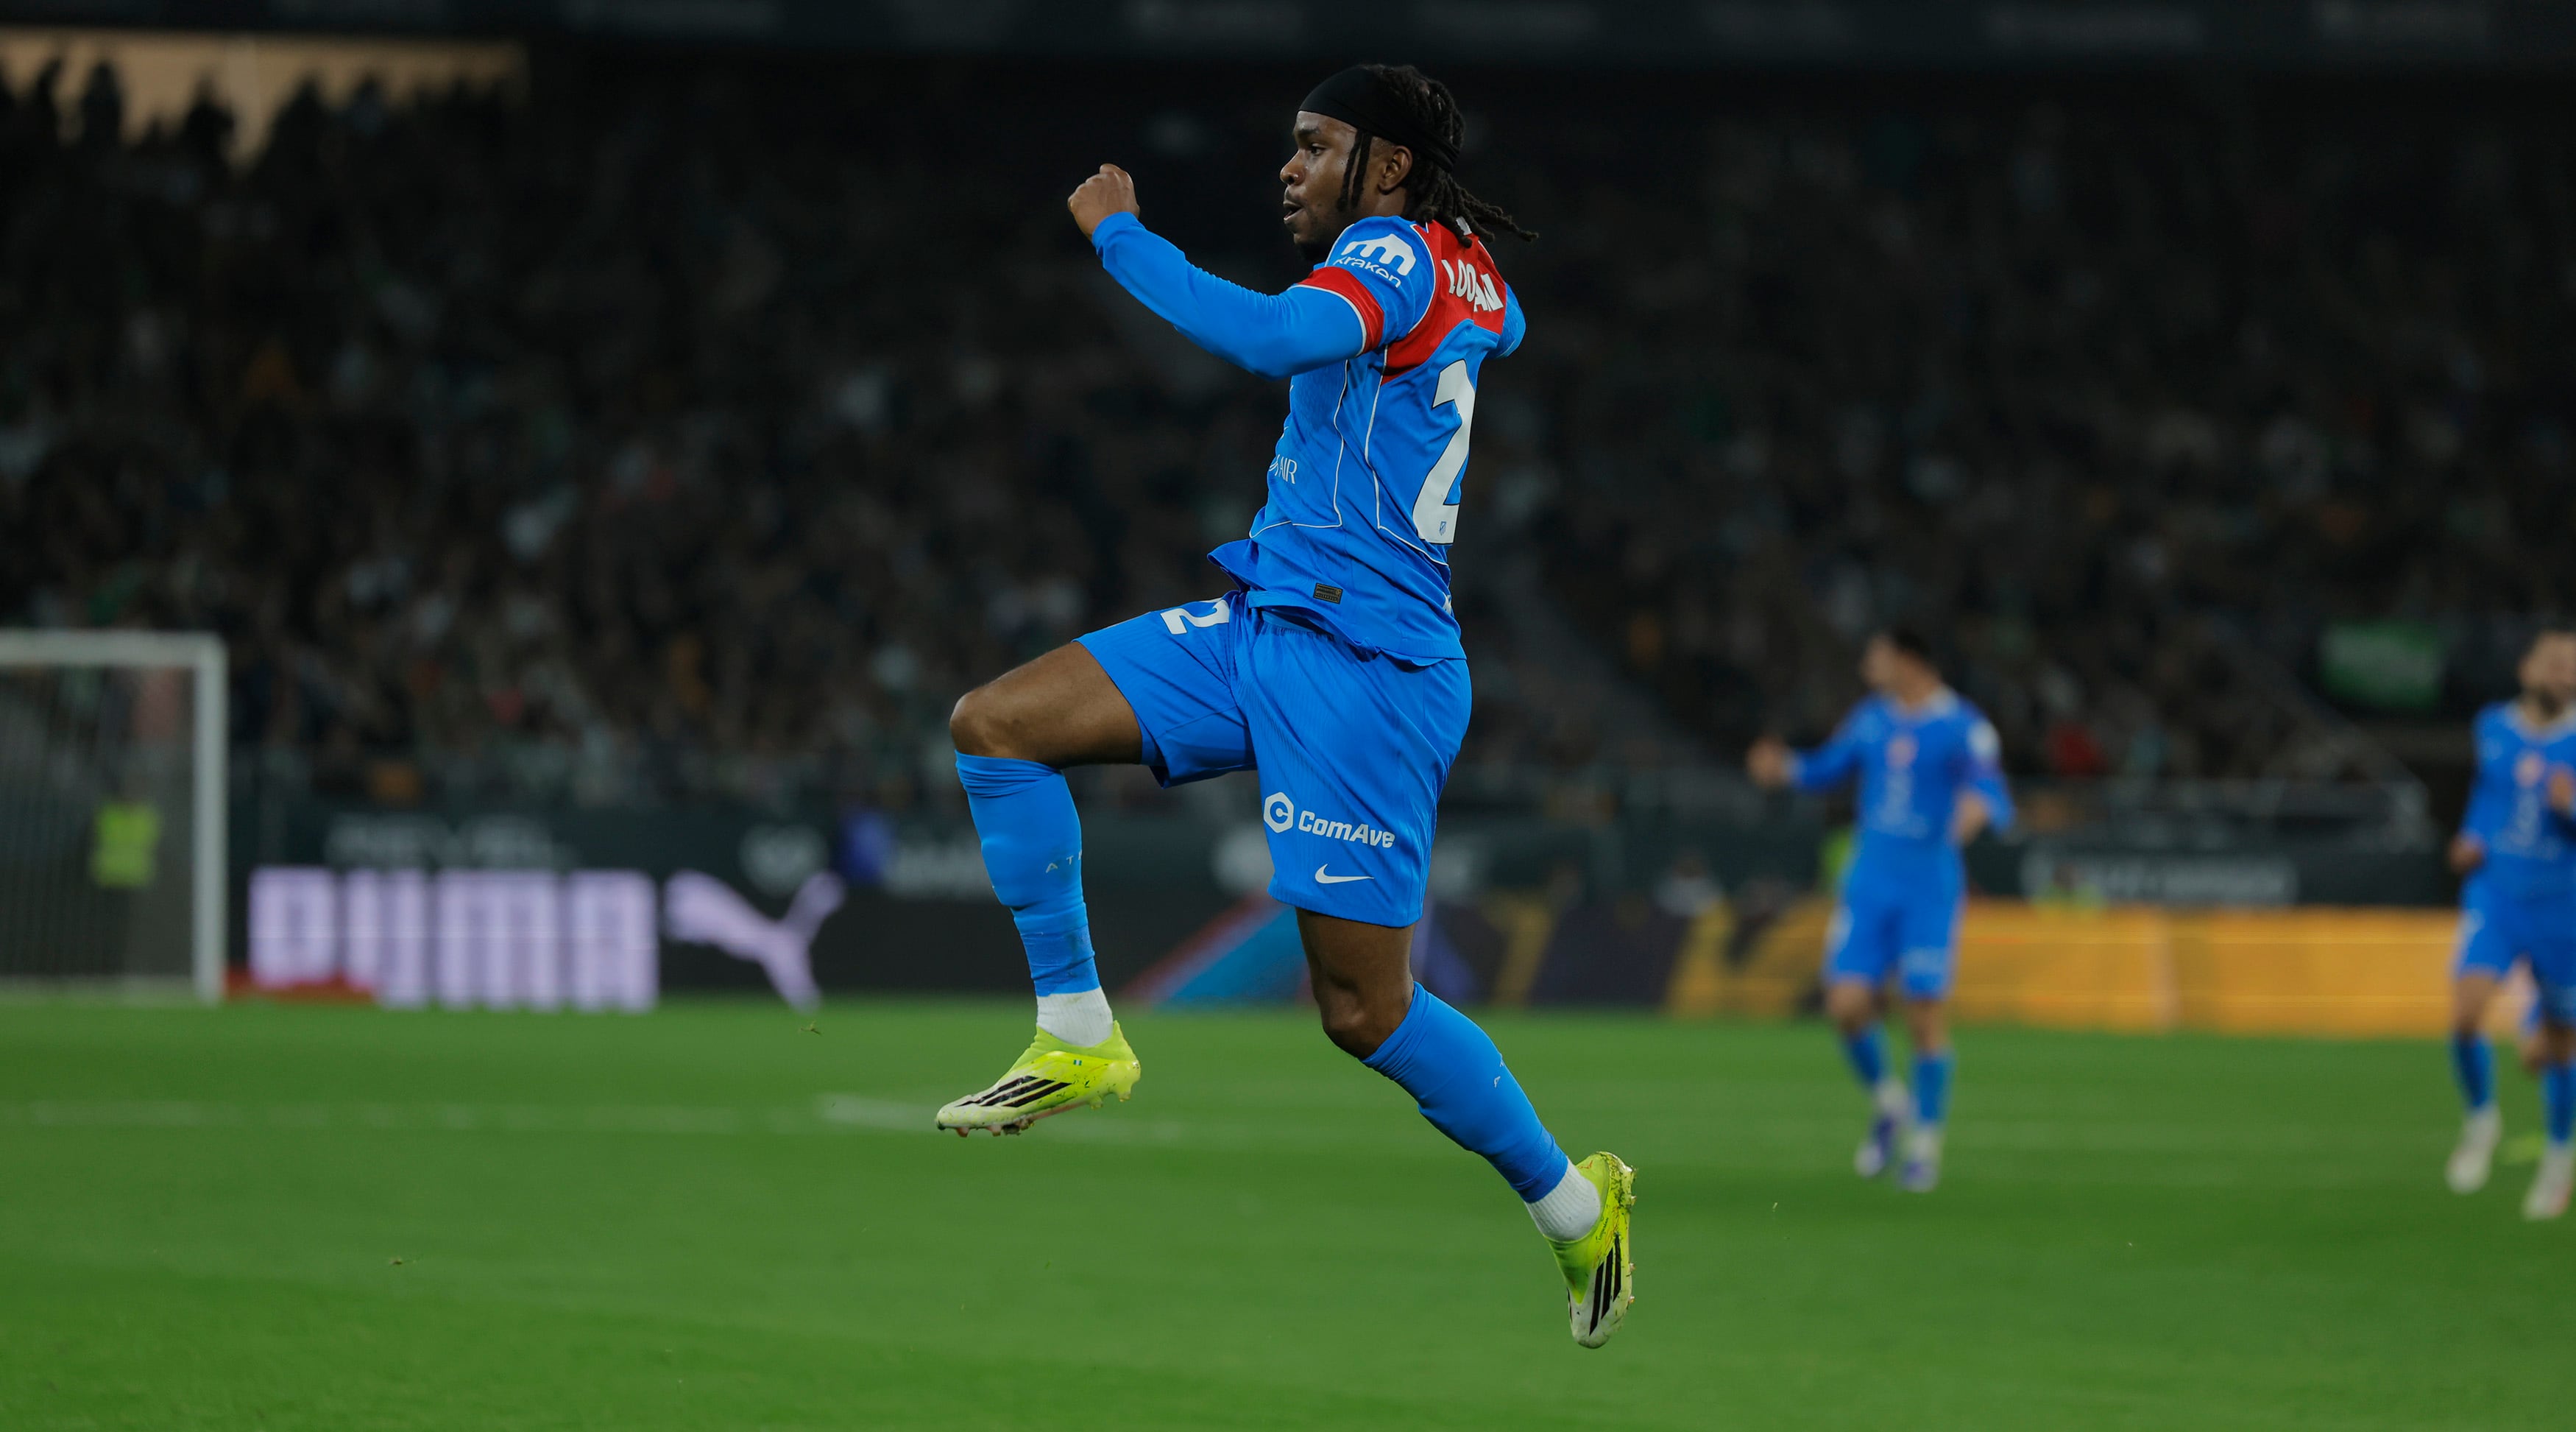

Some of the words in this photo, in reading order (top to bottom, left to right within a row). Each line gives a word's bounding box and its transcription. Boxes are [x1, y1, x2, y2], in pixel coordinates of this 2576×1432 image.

[1333, 255, 1401, 288] kraken
[1160, 597, 1230, 635] 2
[1298, 810, 1395, 848] ComAve
